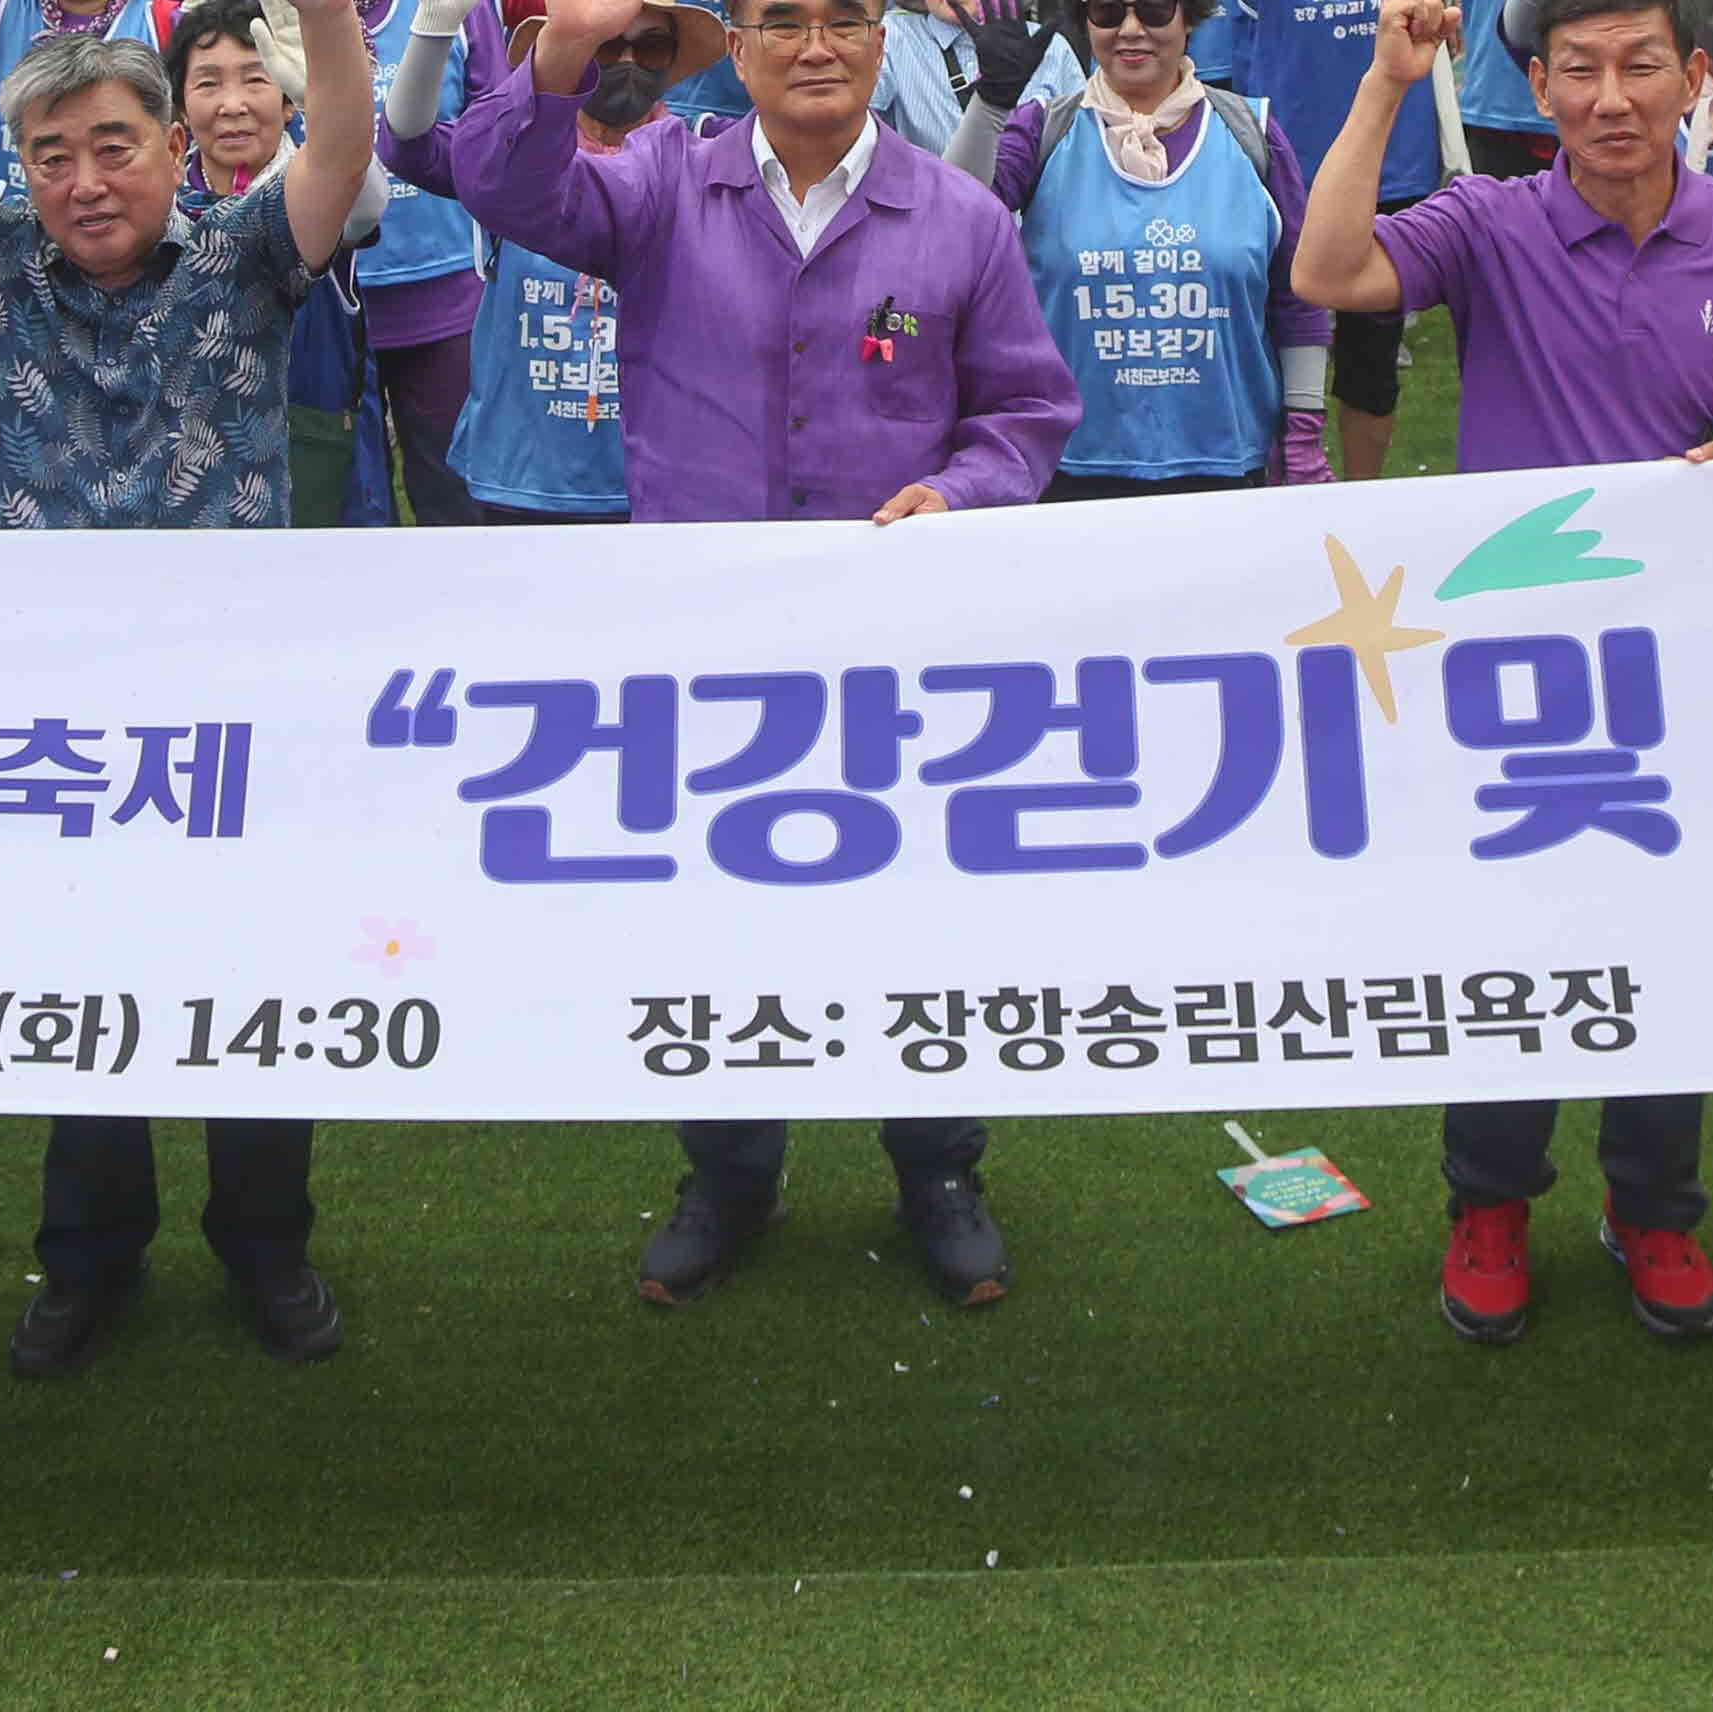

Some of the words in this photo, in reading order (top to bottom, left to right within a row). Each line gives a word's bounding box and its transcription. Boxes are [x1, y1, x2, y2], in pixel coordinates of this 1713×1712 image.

[1078, 249, 1126, 276] 함께
[1132, 248, 1204, 275] 걸어요
[523, 277, 566, 306] 함께
[1093, 326, 1216, 361] 만보걷기
[1114, 366, 1202, 386] 서천군보건소
[1440, 624, 1683, 863] 및
[175, 997, 442, 1071] 14:30
[627, 993, 847, 1077] 장소:
[883, 965, 1643, 1075] 장항송림산림욕장
